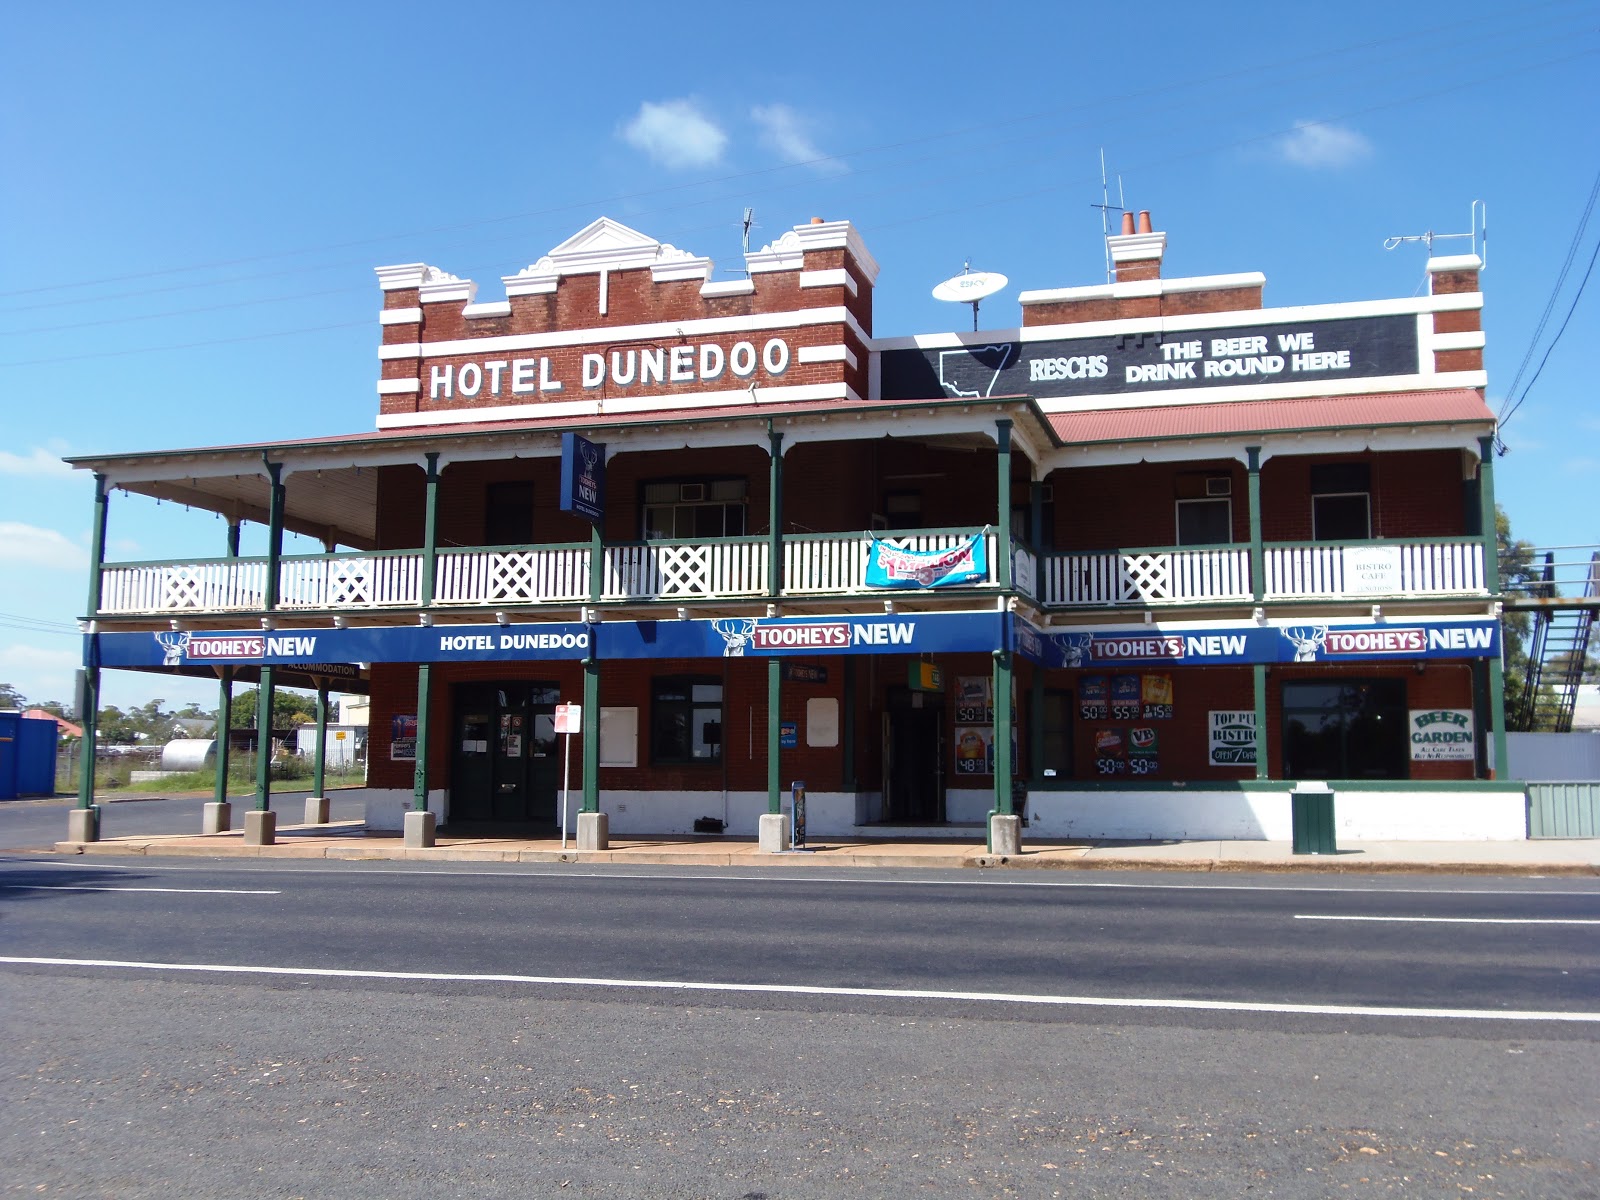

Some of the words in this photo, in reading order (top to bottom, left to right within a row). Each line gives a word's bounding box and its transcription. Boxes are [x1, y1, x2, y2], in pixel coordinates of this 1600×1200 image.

[1160, 340, 1203, 361] THE
[1211, 336, 1268, 357] BEER
[1277, 332, 1314, 351] WE
[430, 357, 563, 399] HOTEL
[582, 338, 790, 387] DUNEDOO
[1029, 355, 1108, 381] RESCHS
[1125, 361, 1197, 383] DRINK
[1204, 355, 1285, 378] ROUND
[1292, 350, 1351, 371] HERE
[579, 485, 597, 503] NEW
[1356, 563, 1392, 571] BISTRO
[440, 636, 495, 650] HOTEL
[500, 633, 589, 649] DUNEDOO
[757, 627, 846, 645] TOOHEYS
[853, 623, 916, 645] NEW
[1328, 632, 1422, 650] TOOHEYS
[1429, 628, 1494, 650] NEW
[190, 640, 261, 656] TOOHEYS
[266, 637, 317, 656] NEW
[1094, 640, 1180, 657] TOOHEYS
[1187, 635, 1247, 656] NEW
[1214, 713, 1235, 726] TOP
[1414, 710, 1469, 729] BEER
[1133, 729, 1153, 741] VB
[1411, 731, 1473, 743] GARDEN
[1215, 750, 1233, 760] OPEN
[1233, 748, 1243, 762] 7
